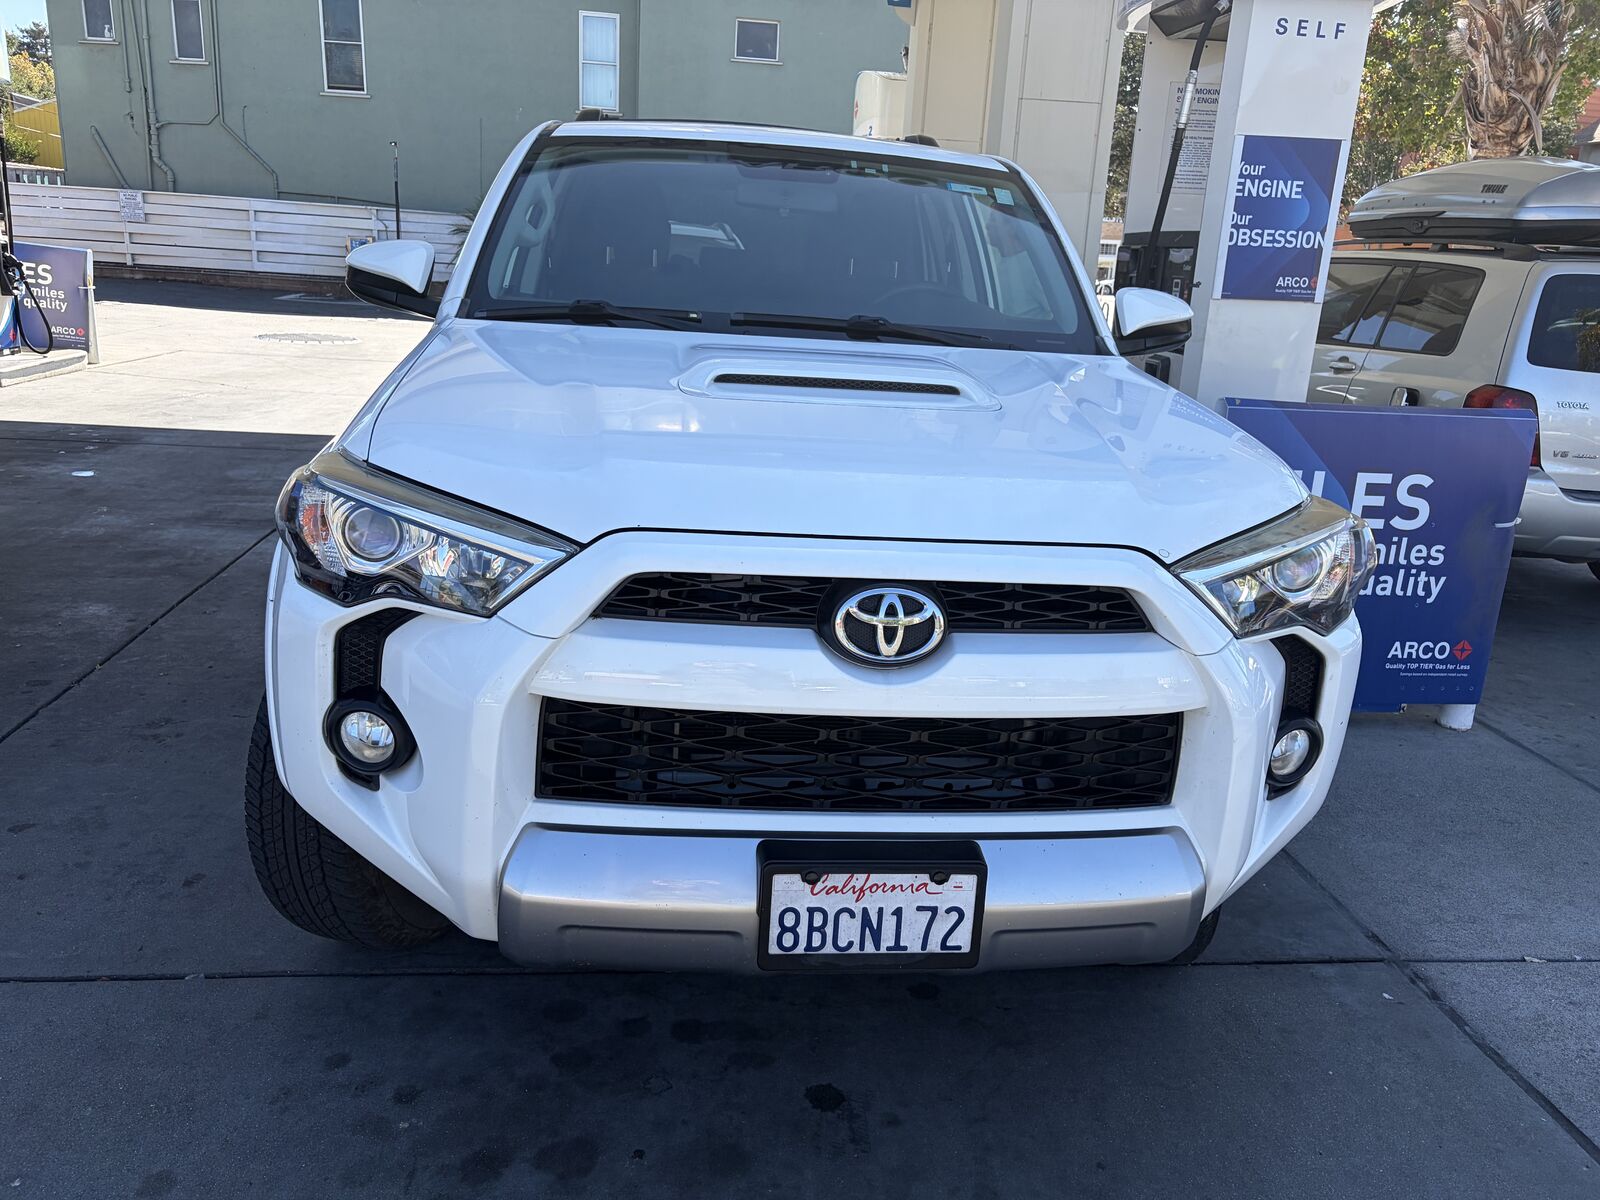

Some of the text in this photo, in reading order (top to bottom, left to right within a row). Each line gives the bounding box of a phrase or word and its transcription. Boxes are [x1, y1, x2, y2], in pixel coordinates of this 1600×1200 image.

[1275, 17, 1346, 40] SELF
[1195, 88, 1220, 96] MOKIN
[1197, 97, 1219, 105] ENGIN
[1239, 161, 1266, 176] Your
[1235, 178, 1304, 199] ENGINE
[1480, 183, 1509, 194] THULE
[1228, 228, 1324, 249] OBSESSION
[1276, 276, 1309, 288] ARCO
[51, 325, 76, 336] ARCO
[1556, 401, 1590, 410] TOYOTA
[1359, 569, 1447, 604] uality
[1387, 641, 1451, 660] ARCO
[810, 873, 943, 903] California
[776, 906, 966, 952] 8BCN172
